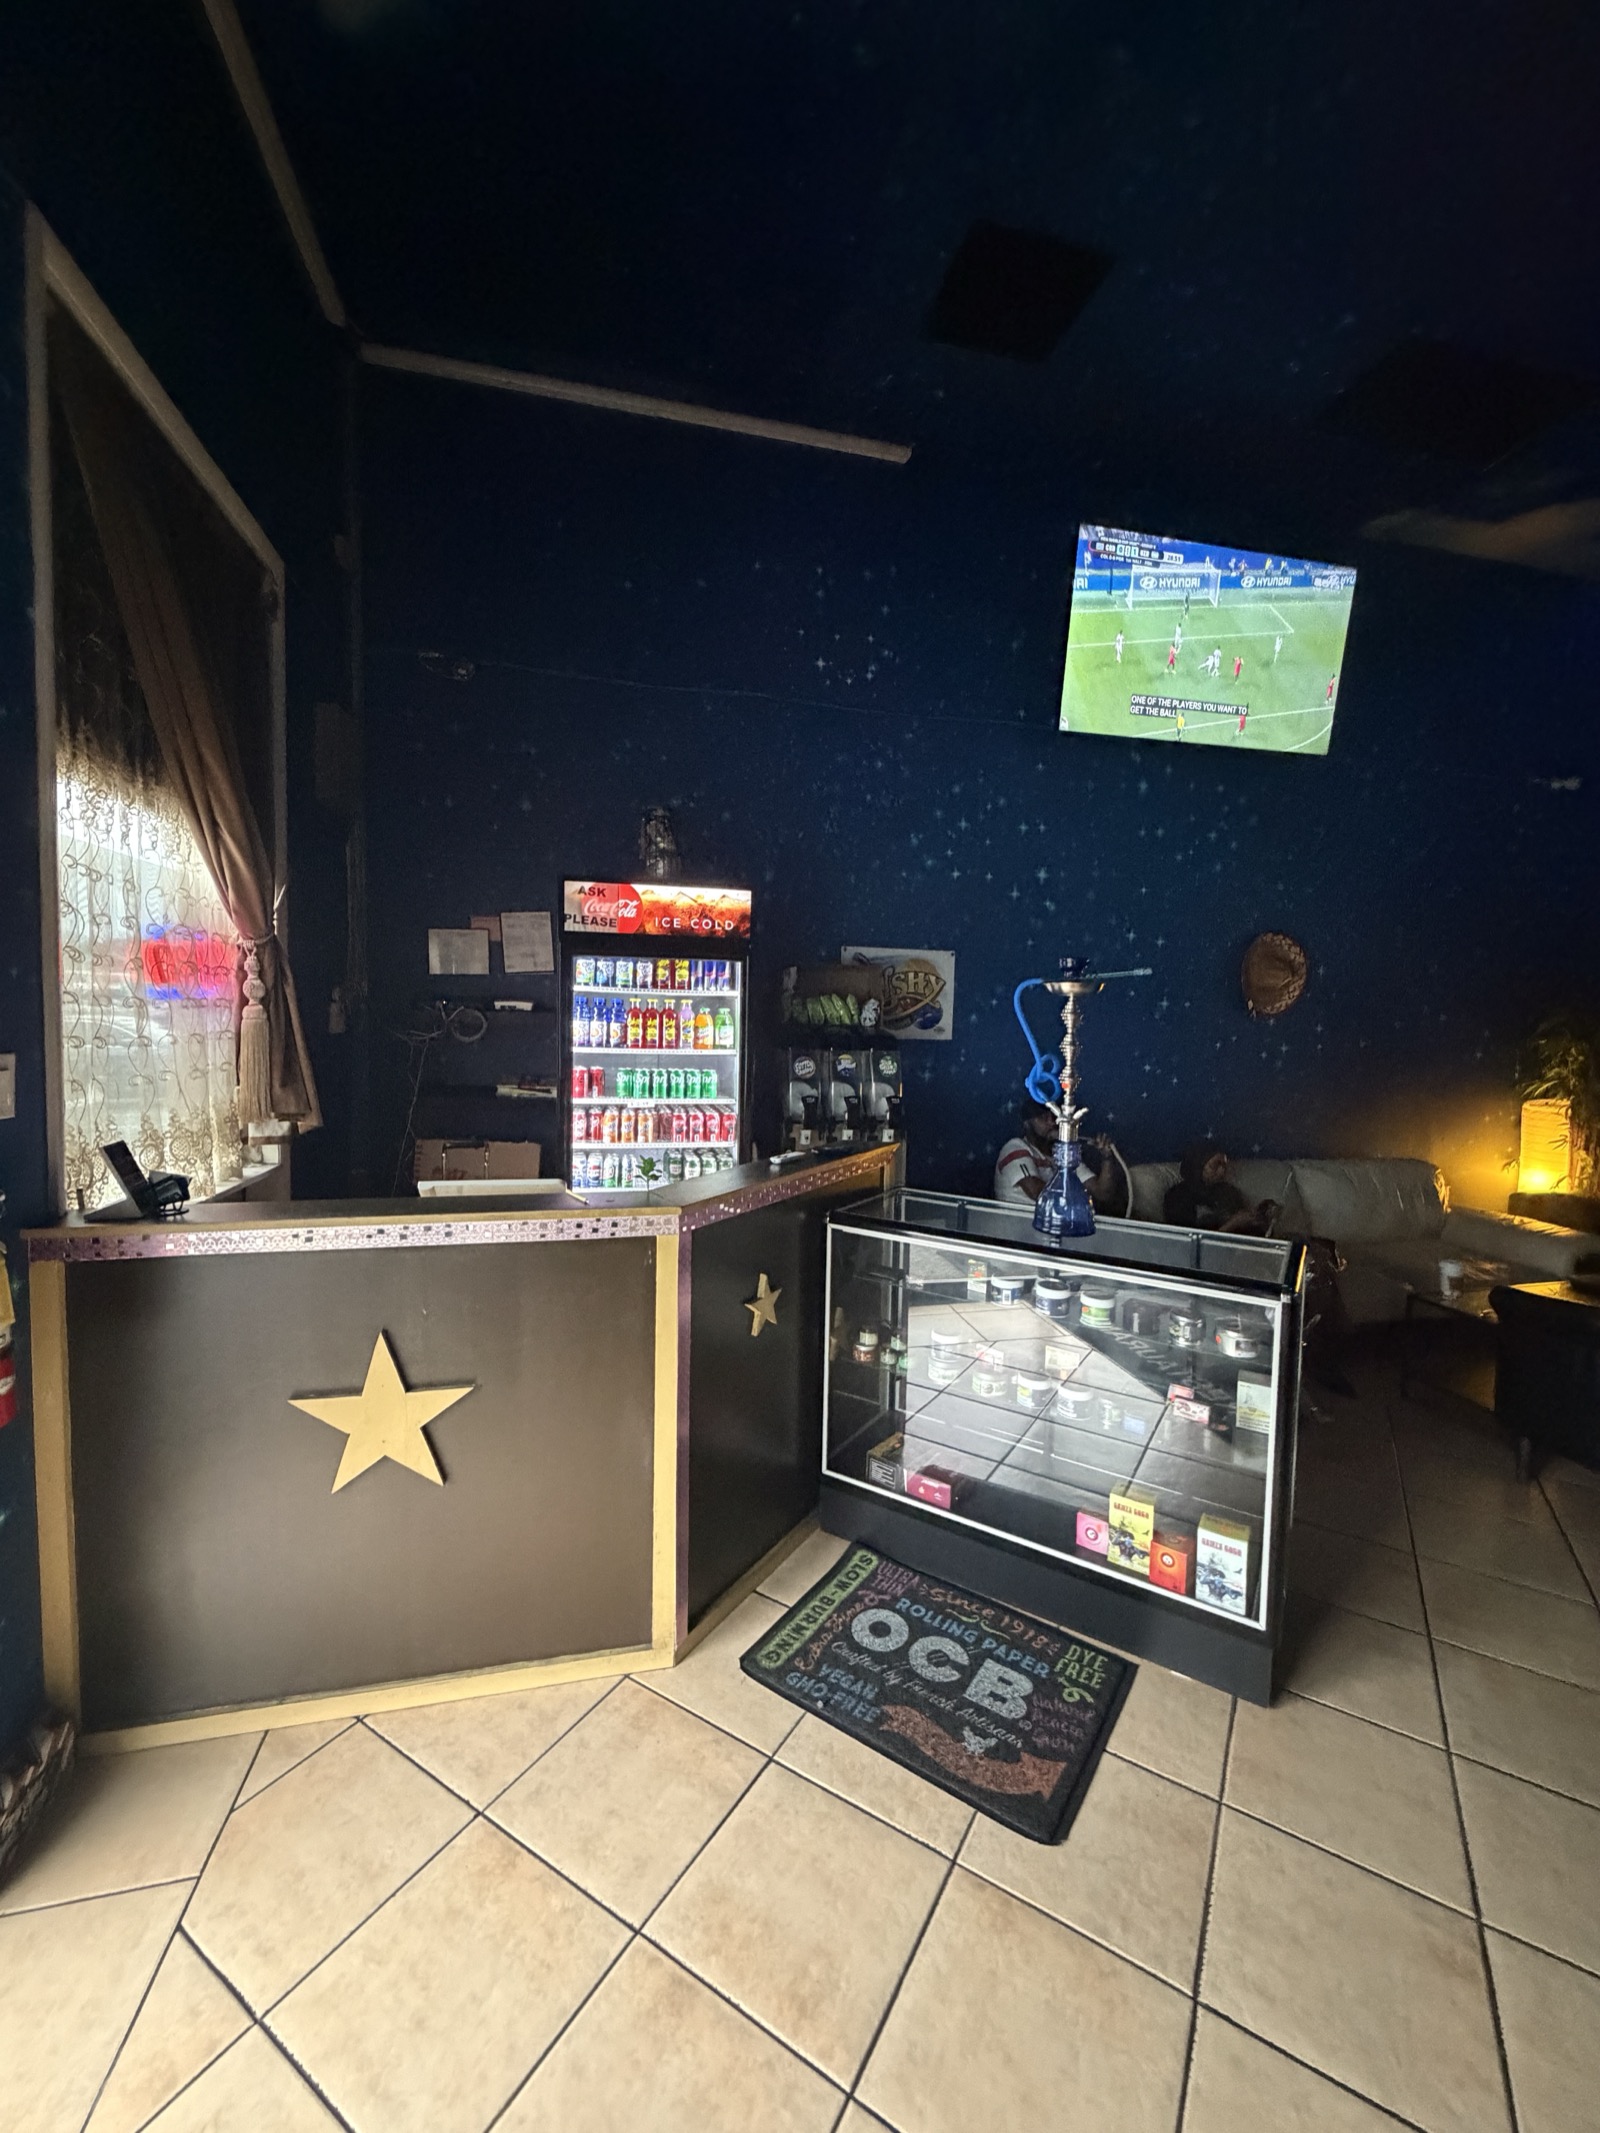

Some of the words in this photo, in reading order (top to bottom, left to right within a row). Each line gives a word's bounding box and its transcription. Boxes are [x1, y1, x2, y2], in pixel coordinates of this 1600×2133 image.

[1158, 575, 1201, 588] HYUNDAI
[1256, 576, 1292, 587] HYUNDAI
[1130, 705, 1144, 715] GET
[1145, 706, 1159, 716] THE
[1160, 708, 1177, 717] BALL
[1131, 695, 1147, 705] ONE
[1147, 697, 1157, 706] OF
[1158, 698, 1171, 708] THE
[1172, 699, 1202, 711] PLAYERS
[1203, 702, 1217, 712] YOU
[1217, 703, 1237, 714] WANT
[1238, 706, 1248, 715] TO
[577, 886, 606, 898] ASK
[565, 913, 617, 928] PLEASE
[655, 916, 682, 928] ICE
[690, 918, 735, 931] COLD
[871, 1574, 908, 1597] THIN
[876, 1560, 922, 1588] ULTRA
[764, 1552, 874, 1664] SLOW-BURNING
[928, 1586, 996, 1618] Since
[1000, 1614, 1050, 1650] 1918
[895, 1597, 980, 1644] ROLLING
[981, 1636, 1052, 1679] PAPER
[851, 1607, 1034, 1720] OCB
[1065, 1643, 1110, 1673] DYE
[818, 1663, 879, 1700] VEGAN
[1053, 1658, 1106, 1690] FREE
[830, 1641, 889, 1673] Crafted
[955, 1708, 1023, 1749] Artisans
